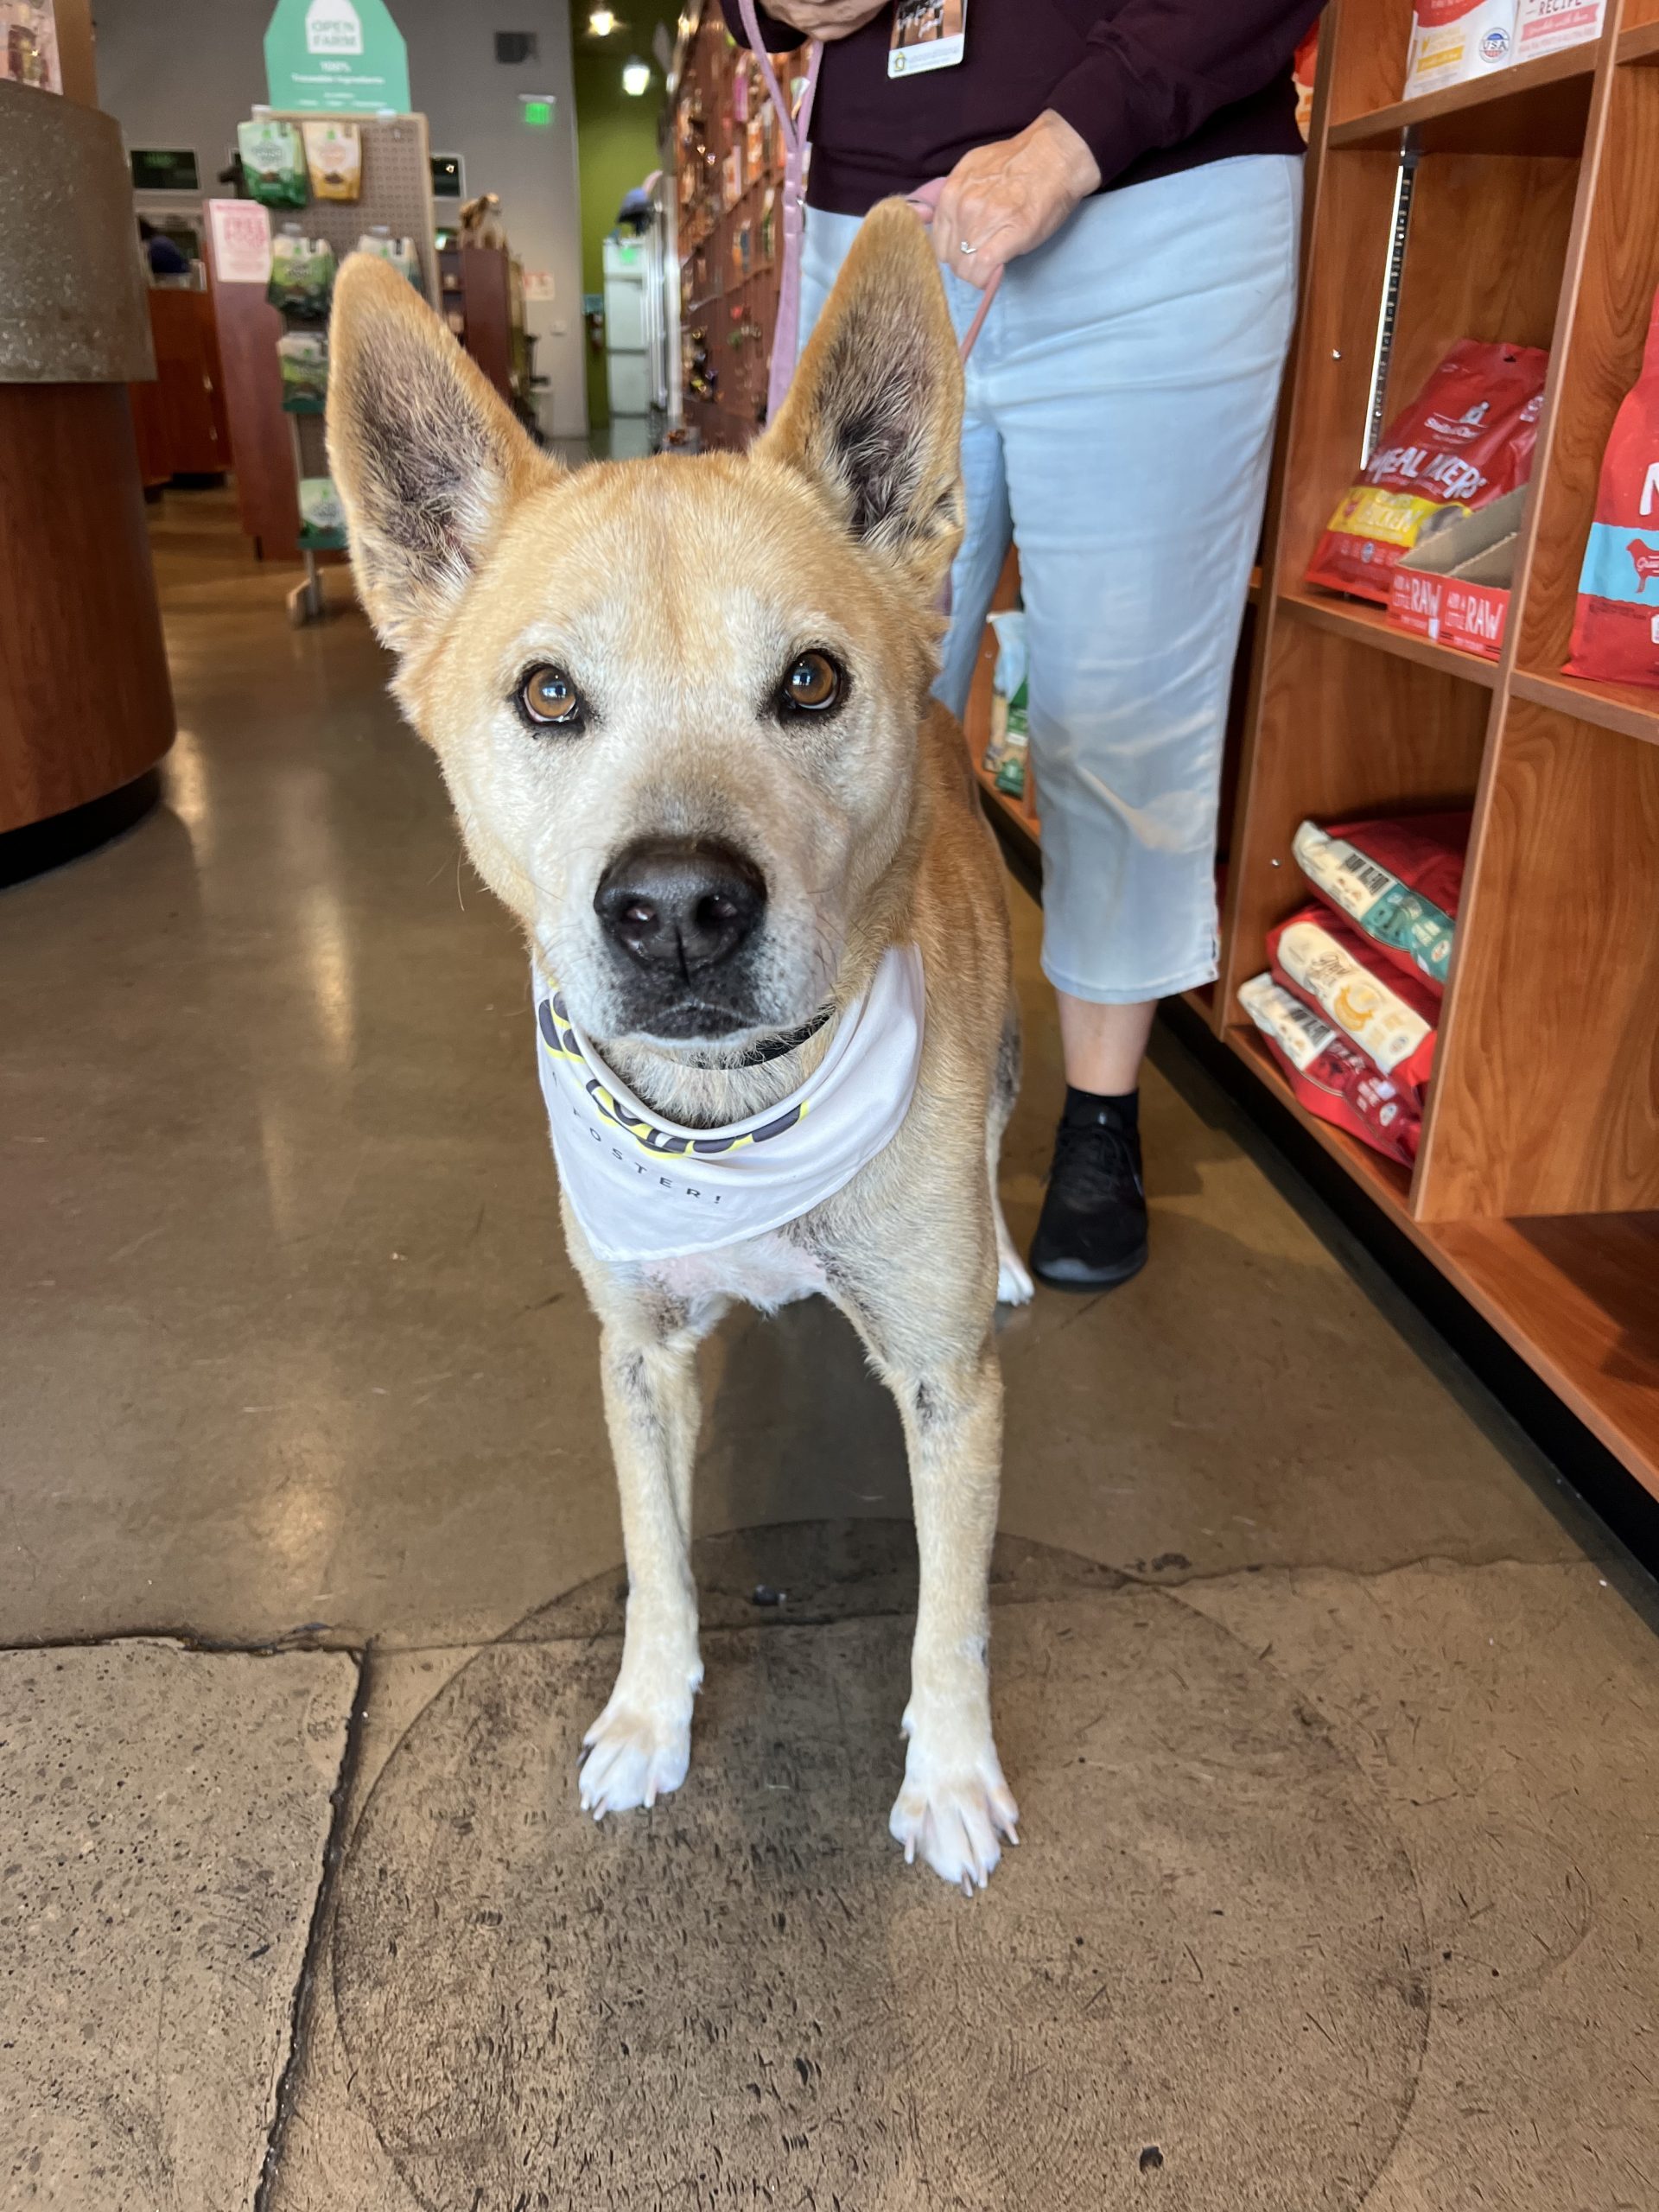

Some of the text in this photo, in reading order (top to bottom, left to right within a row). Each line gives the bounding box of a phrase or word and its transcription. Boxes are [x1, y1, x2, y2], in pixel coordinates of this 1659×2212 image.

[311, 20, 355, 33] OPEN
[313, 35, 357, 46] FARM
[1483, 40, 1509, 52] USA
[320, 60, 352, 73] 100%
[1368, 447, 1427, 484] MEAL
[1411, 578, 1443, 618] RAW
[1465, 595, 1503, 639] RAW
